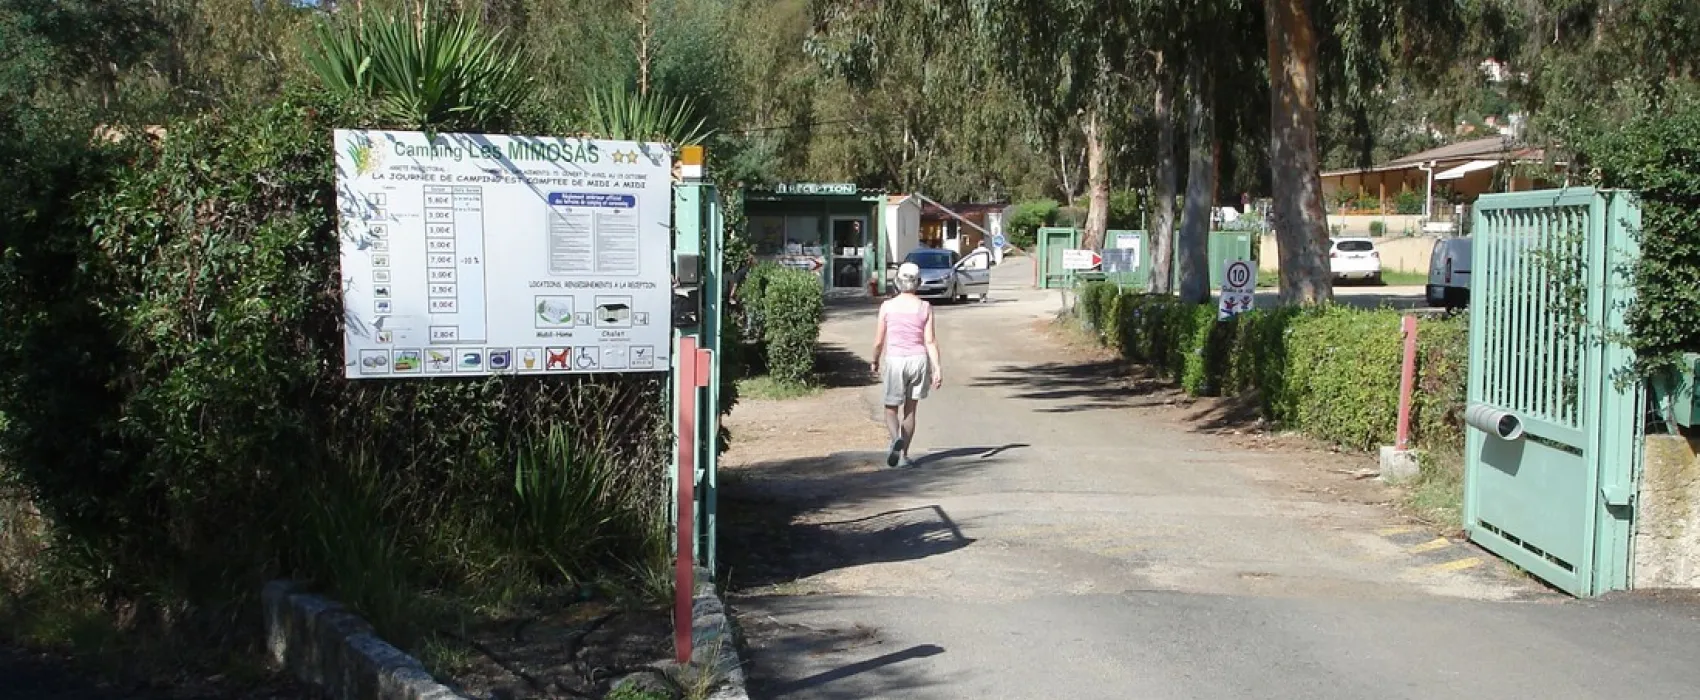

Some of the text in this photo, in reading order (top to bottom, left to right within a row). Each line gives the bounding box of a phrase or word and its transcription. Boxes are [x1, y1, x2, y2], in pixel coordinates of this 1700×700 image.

[394, 140, 599, 164] Camping Les MIMOSAS
[372, 172, 384, 180] LA
[388, 173, 436, 181] JOURNEE
[440, 174, 452, 182] DE
[526, 177, 568, 186] COMPTEE
[587, 180, 610, 188] MIDI
[623, 181, 646, 189] MIDI
[1232, 269, 1245, 282] 10
[601, 330, 625, 338] Chalet
